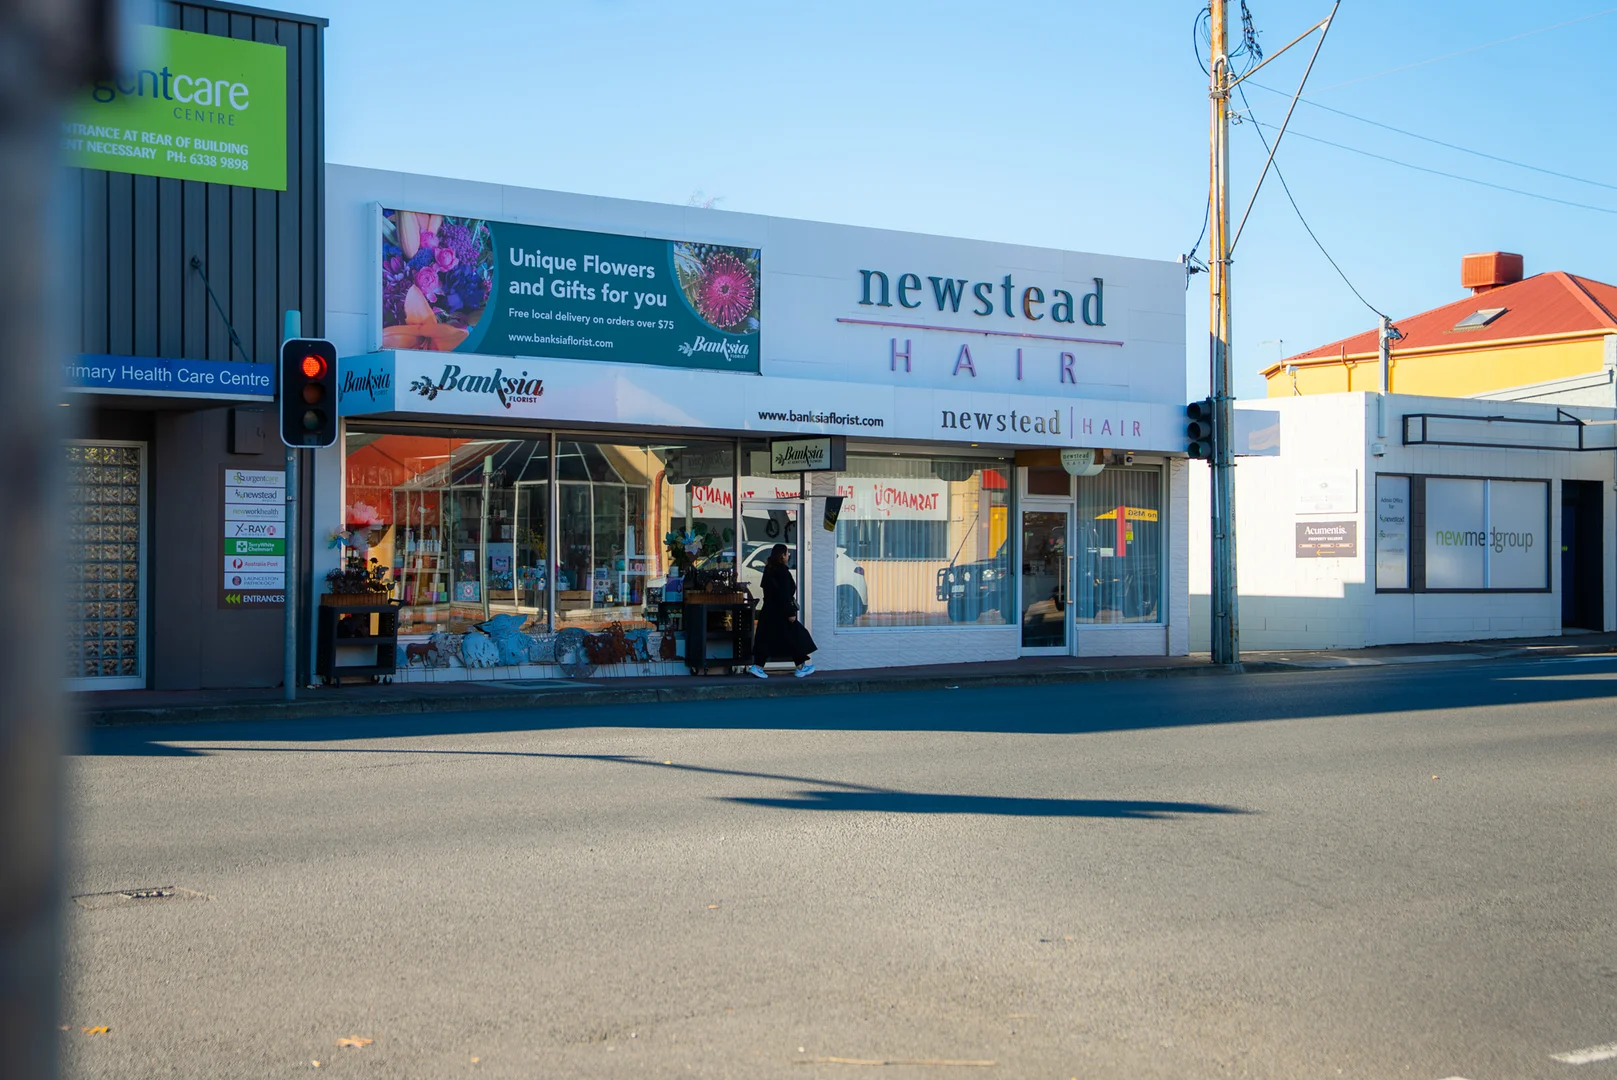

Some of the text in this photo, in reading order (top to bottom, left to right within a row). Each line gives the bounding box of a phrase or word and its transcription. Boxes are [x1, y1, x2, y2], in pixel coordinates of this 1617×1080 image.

[173, 107, 235, 126] CENTRE
[123, 130, 138, 142] AT
[141, 131, 172, 146] REAR
[175, 136, 191, 149] OF
[193, 139, 249, 155] BUILDING
[86, 140, 157, 159] NECESSARY
[166, 150, 187, 163] PH:
[189, 153, 217, 167] 6338
[220, 156, 249, 171] 9898
[509, 247, 656, 279] Unique Flowers
[508, 277, 667, 310] and Gifts for you
[858, 268, 1107, 327] newstead
[508, 308, 675, 330] Free local delivery on orders over $75
[508, 332, 614, 349] www.banksiaflorist.com
[692, 335, 749, 362] Banksia
[889, 337, 1078, 385] HAIR
[61, 362, 270, 387] rimary Health Care Centre
[343, 367, 390, 402] Banksia
[436, 363, 544, 410] Banksia
[508, 396, 538, 404] FLORIST
[757, 409, 885, 428] www.banksiaflorist.com
[941, 408, 1142, 437] newstead HAIR
[783, 445, 825, 467] Banksia
[1062, 451, 1090, 459] newstead
[243, 491, 277, 499] newstead
[235, 523, 267, 536] X-RAY
[243, 594, 285, 603] ENTRANCES
